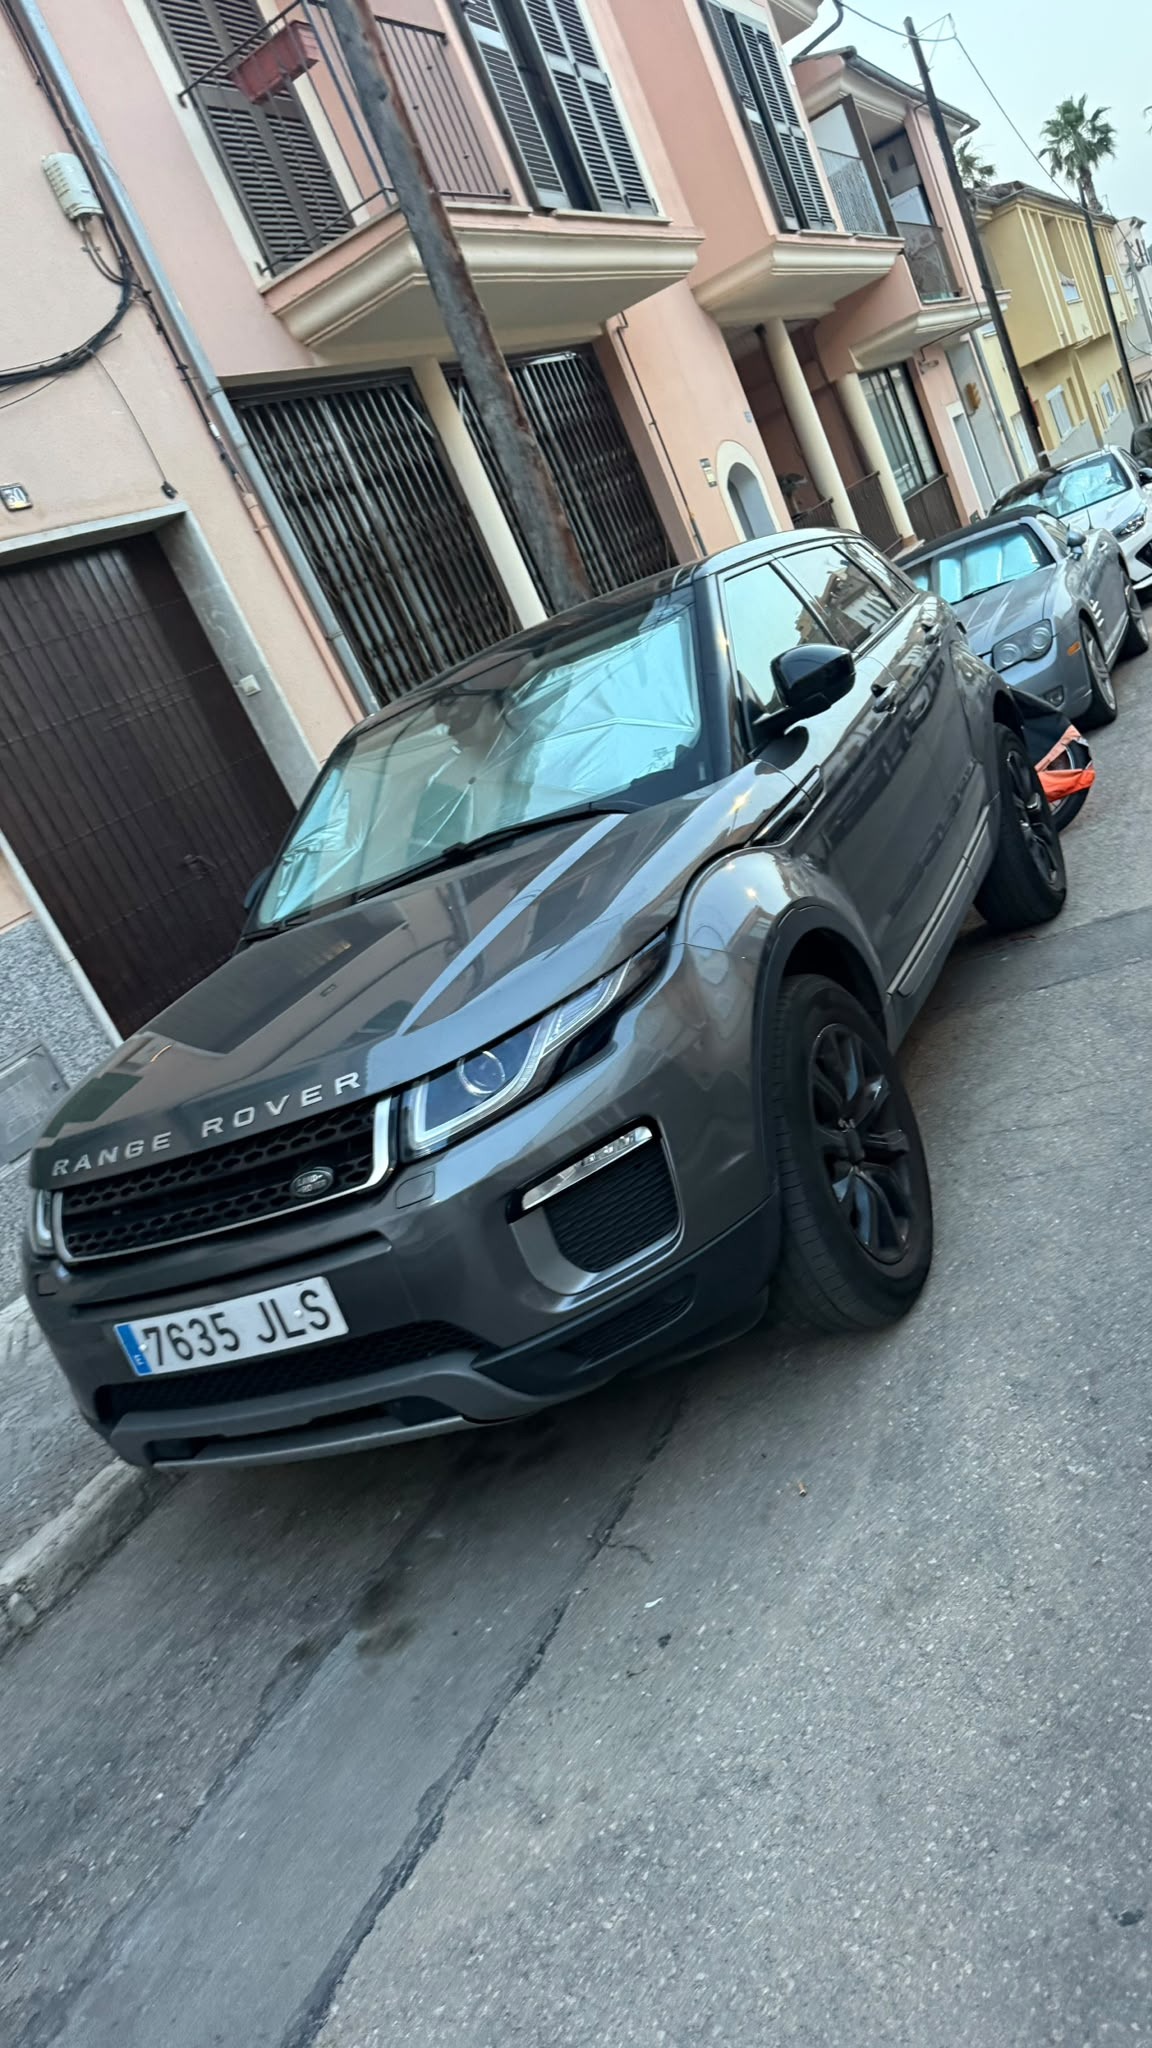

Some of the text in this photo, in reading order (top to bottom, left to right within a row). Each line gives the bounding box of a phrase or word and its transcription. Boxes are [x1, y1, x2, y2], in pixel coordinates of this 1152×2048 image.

[52, 1071, 361, 1176] RANGE ROVER
[141, 1289, 331, 1366] 7635 JLS
